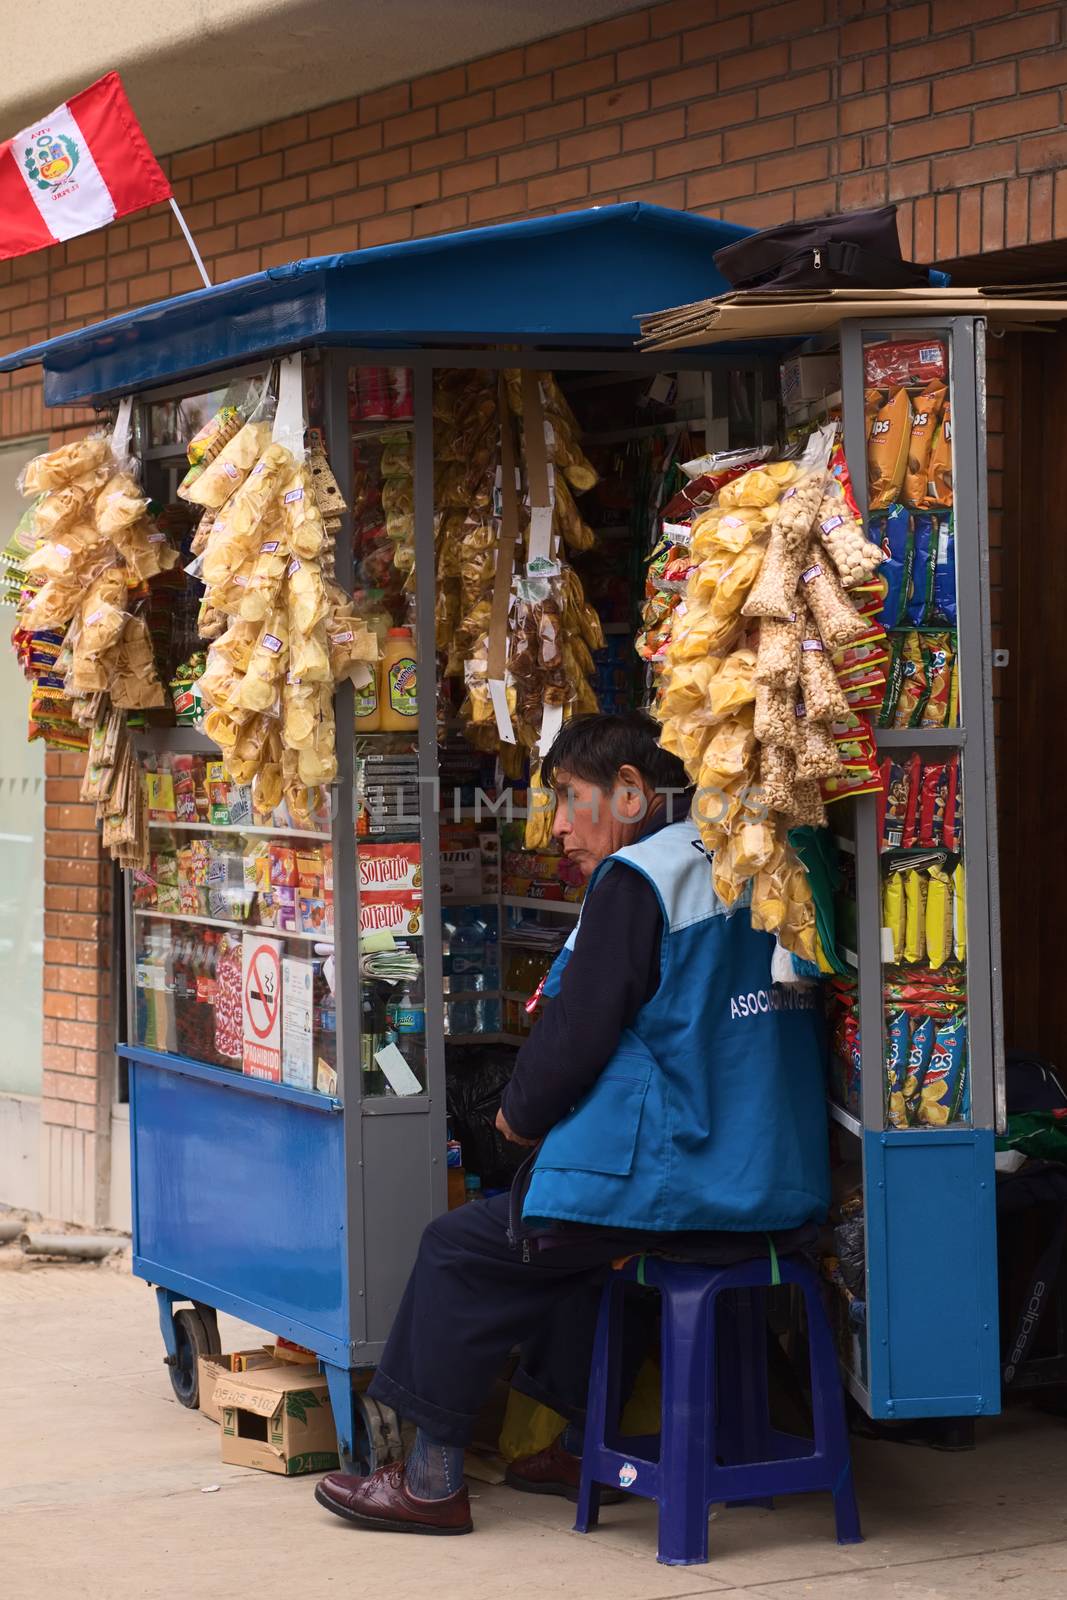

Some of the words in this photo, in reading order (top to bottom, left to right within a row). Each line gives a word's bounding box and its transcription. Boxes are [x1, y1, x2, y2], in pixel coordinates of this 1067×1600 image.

[394, 663, 417, 691] TAMPICO
[360, 855, 409, 886] Sorrento
[1010, 1281, 1045, 1364] eclipse
[225, 1411, 233, 1426] 7
